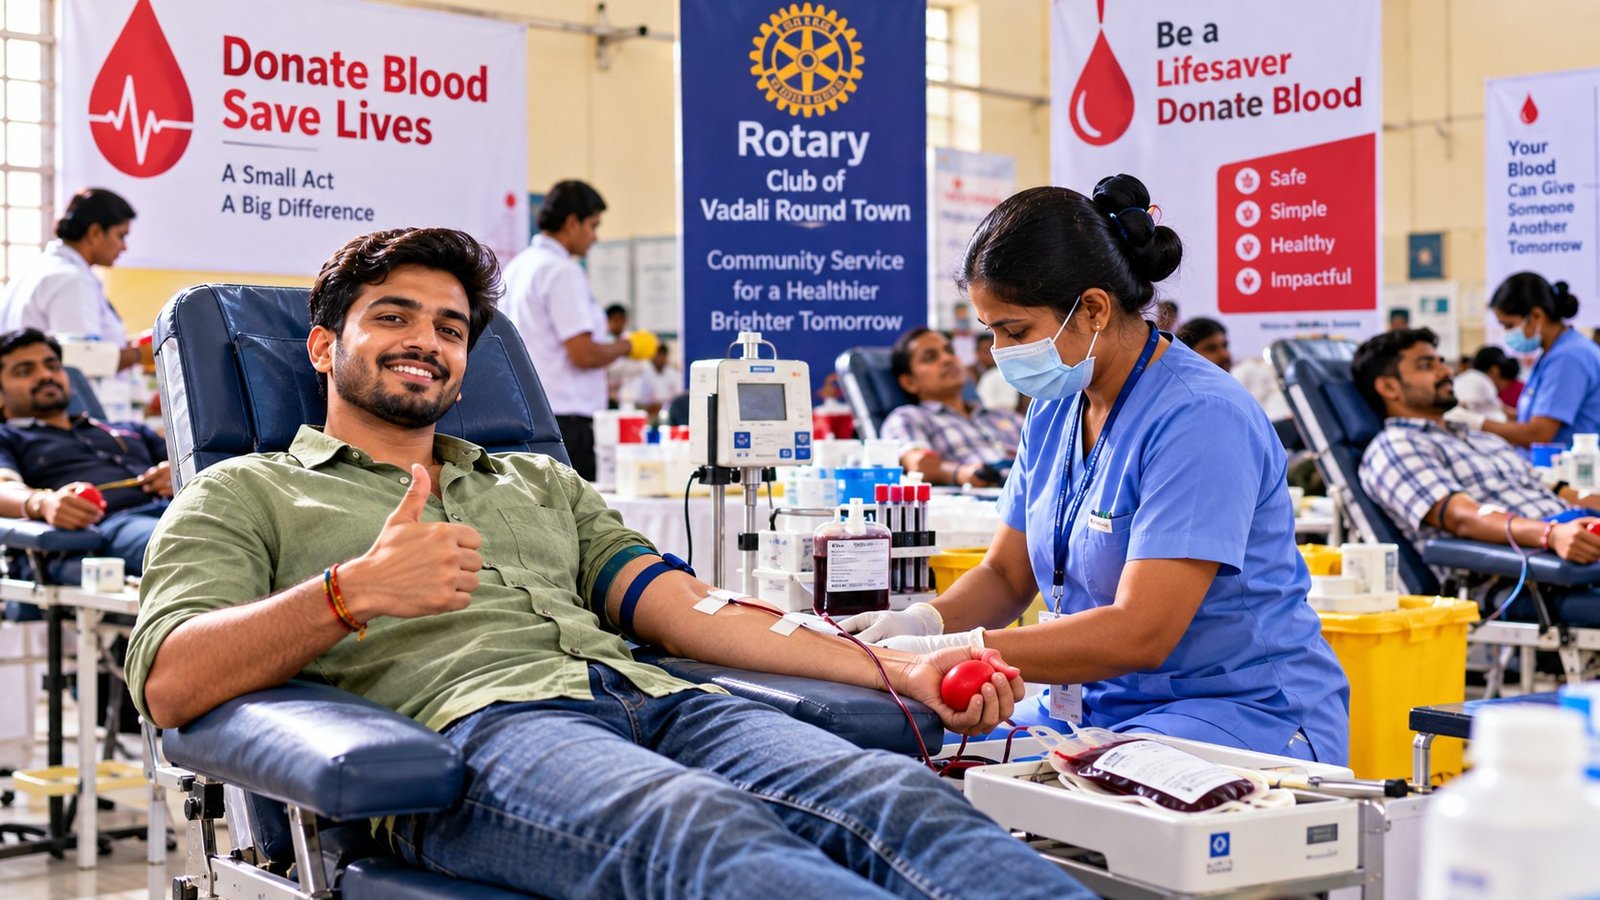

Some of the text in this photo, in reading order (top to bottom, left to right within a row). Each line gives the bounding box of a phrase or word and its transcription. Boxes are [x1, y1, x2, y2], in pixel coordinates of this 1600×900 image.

[1157, 21, 1219, 49] Be a
[223, 35, 488, 103] Donate Blood
[1157, 52, 1293, 88] Lifesaver
[1157, 76, 1362, 126] Donate Blood
[222, 89, 433, 146] Save Lives
[738, 120, 870, 167] Rotary
[1508, 140, 1548, 156] Your
[221, 163, 334, 190] A Small Act
[766, 168, 846, 193] Club of
[1270, 167, 1307, 187] Safe
[1507, 159, 1556, 178] Blood
[1507, 180, 1575, 198] Can Give
[221, 194, 375, 222] A Big Difference
[700, 197, 911, 222] Vadali Round Town
[1270, 199, 1328, 224] Simple
[1508, 202, 1575, 217] Someone
[1508, 220, 1568, 235] Another
[1270, 234, 1336, 257] Healthy
[1508, 240, 1583, 255] Tomorrow
[707, 249, 905, 275] Community Service
[732, 279, 879, 301] for a Healthier
[1271, 267, 1352, 291] Impactful
[711, 310, 903, 332] Brighter Tomorrow
